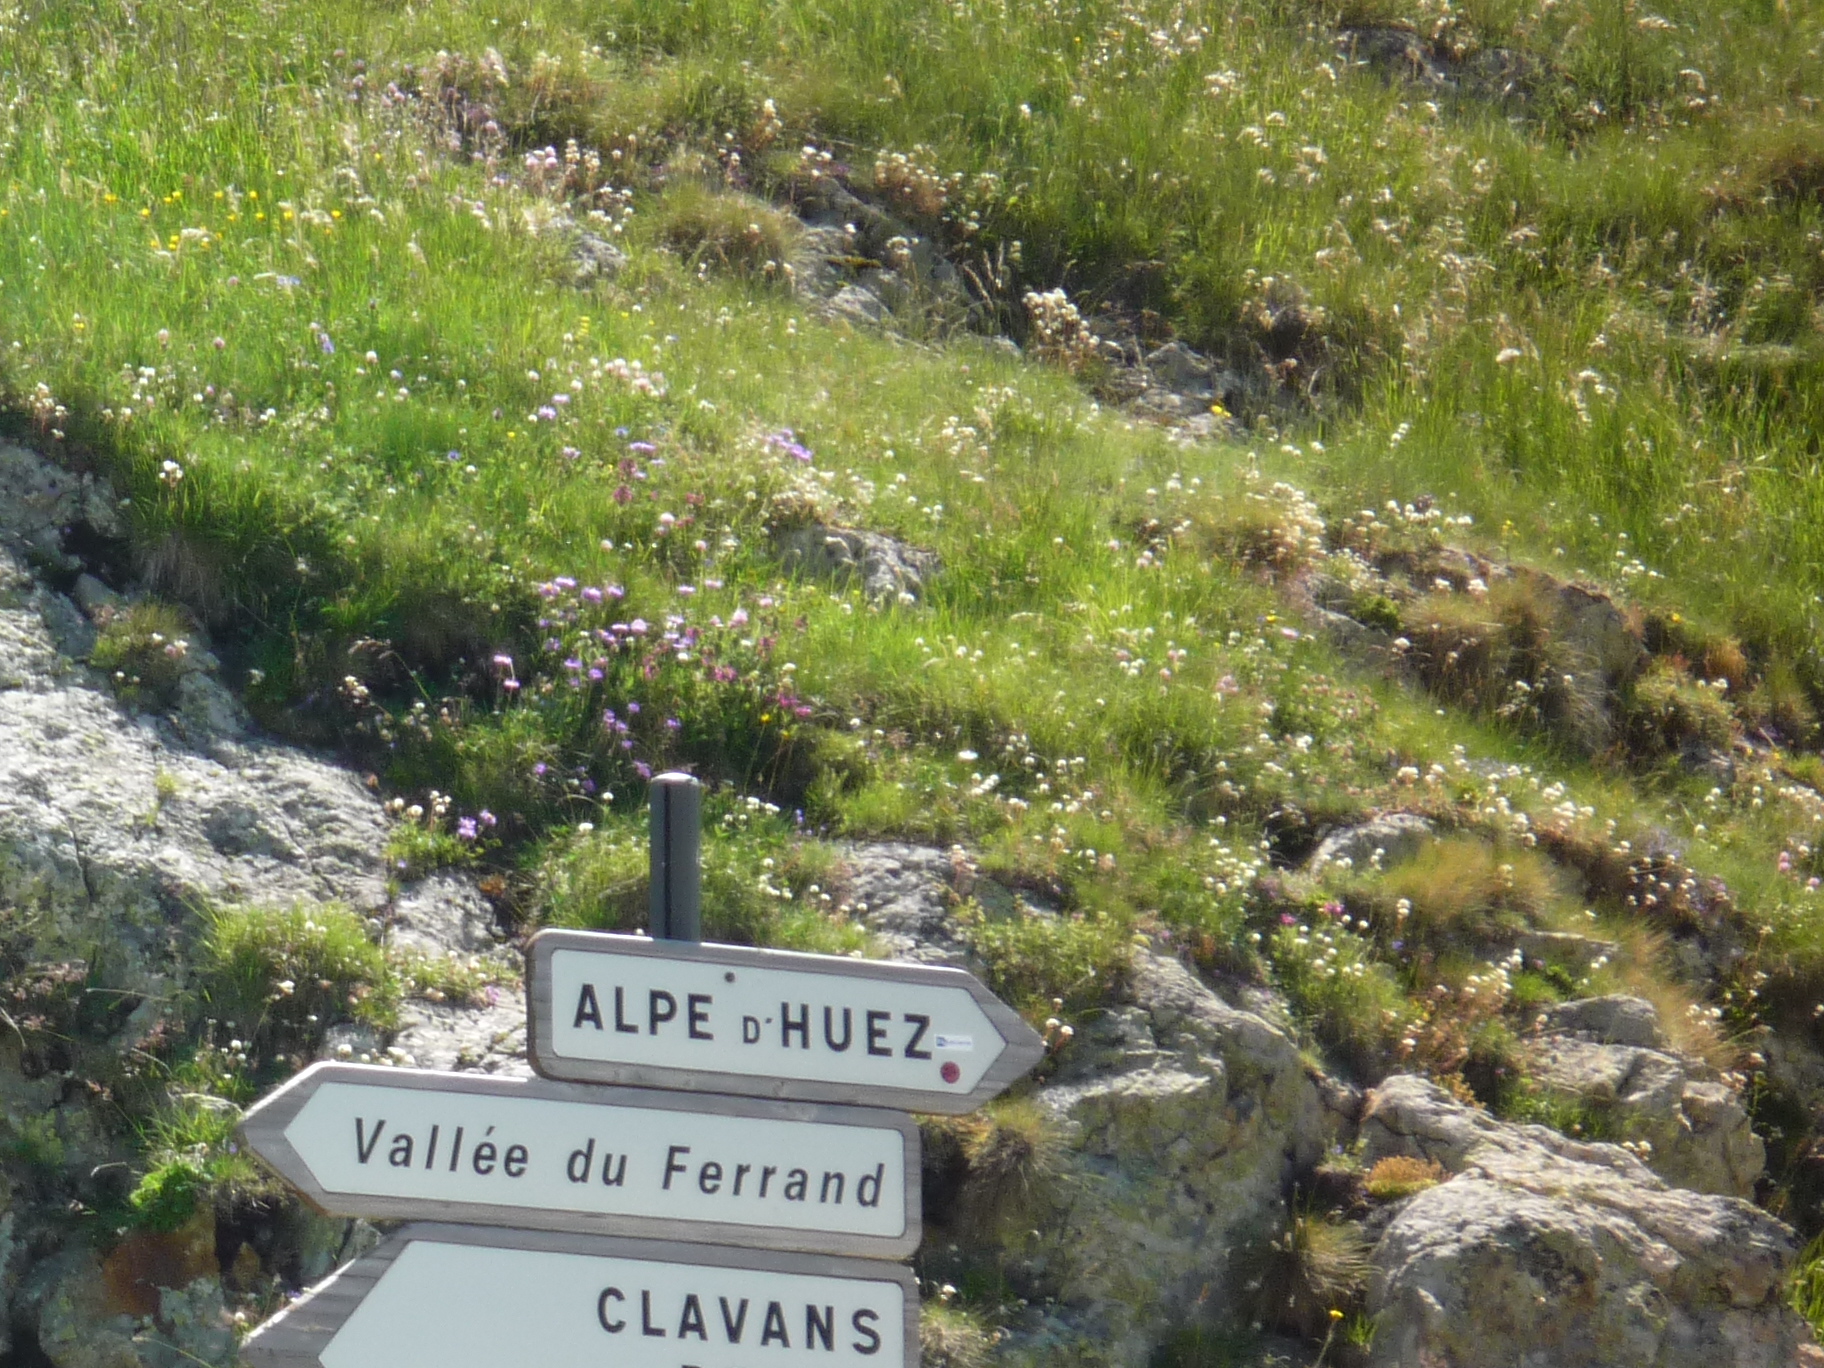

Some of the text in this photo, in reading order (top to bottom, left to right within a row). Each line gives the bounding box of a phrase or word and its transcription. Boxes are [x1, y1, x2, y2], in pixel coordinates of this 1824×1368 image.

[573, 983, 714, 1042] ALPE
[353, 1116, 886, 1209] Vallée du Ferrand
[596, 1286, 882, 1355] CLAVANS
